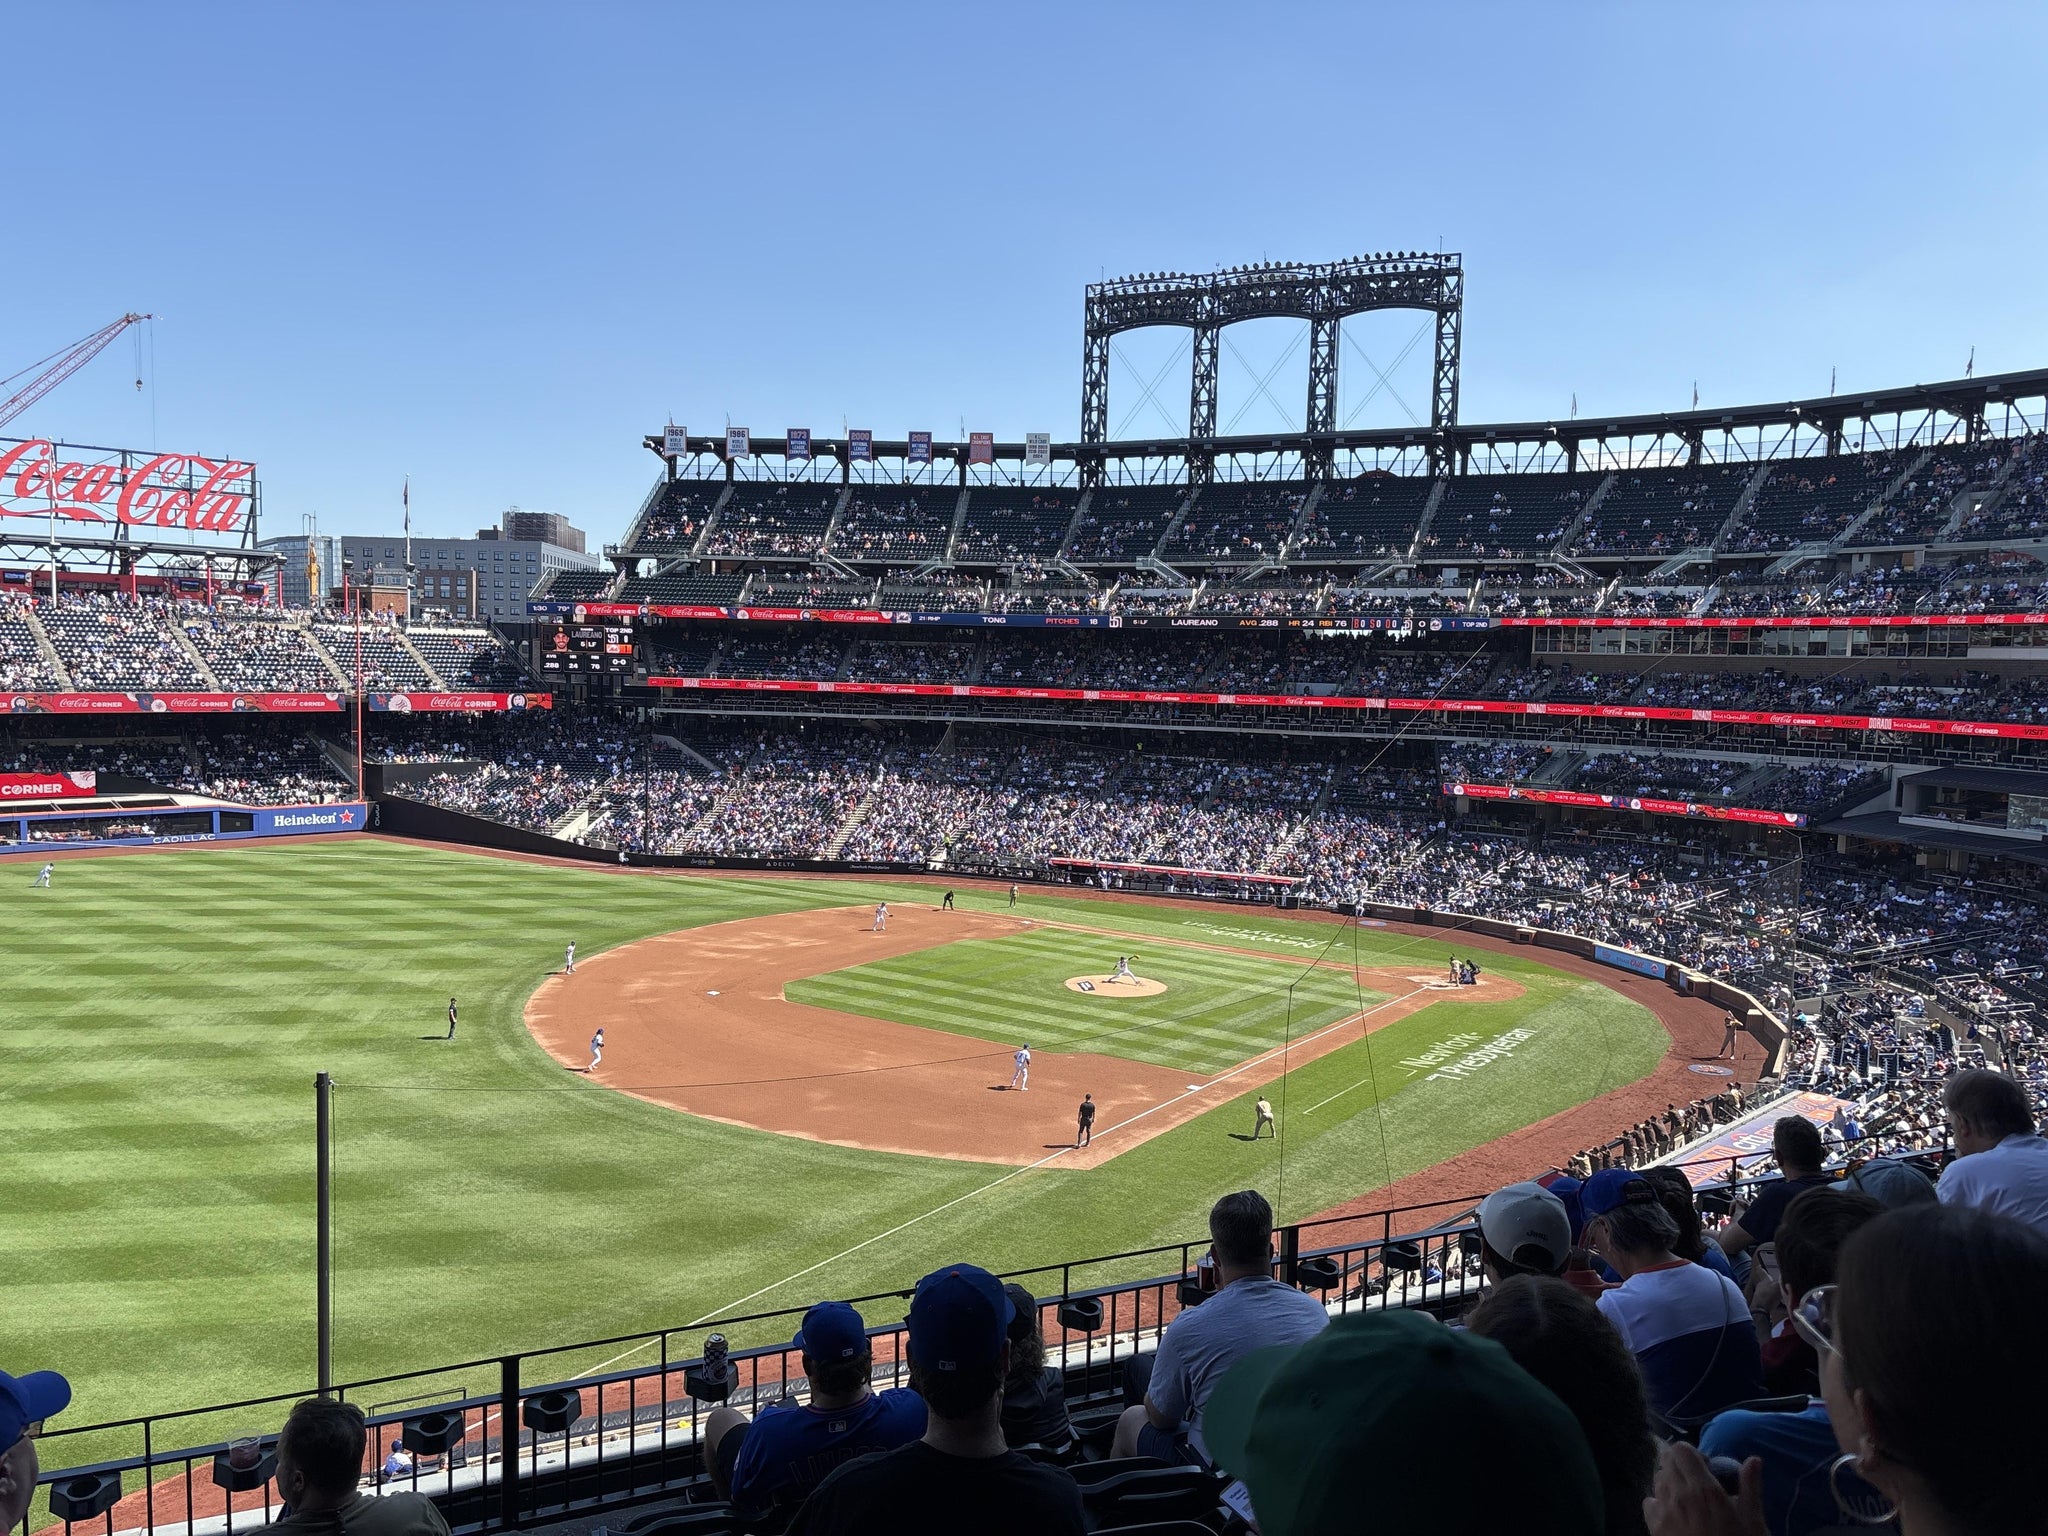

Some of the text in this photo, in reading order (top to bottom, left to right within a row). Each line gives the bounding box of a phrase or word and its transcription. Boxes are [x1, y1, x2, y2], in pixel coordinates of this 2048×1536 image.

[667, 429, 684, 437] 1969
[730, 430, 745, 438] 1986
[590, 605, 612, 614] Coca-Cola
[671, 608, 693, 616] Coca-Cola
[752, 610, 773, 618] Coca-Cola
[833, 612, 855, 620] Coca-Cola
[571, 631, 603, 639] LAUREANO
[59, 698, 89, 708] Coca-Cola
[170, 698, 198, 708] Coca-Cola
[272, 698, 298, 707] Coca-Cola
[431, 696, 463, 708] Coca-Cola
[1869, 717, 1892, 729] DORADO
[1951, 723, 1974, 733] Coca-Cola
[1, 783, 63, 795] CORNER
[274, 812, 337, 827] Heineken
[153, 834, 216, 844] CADILLAC
